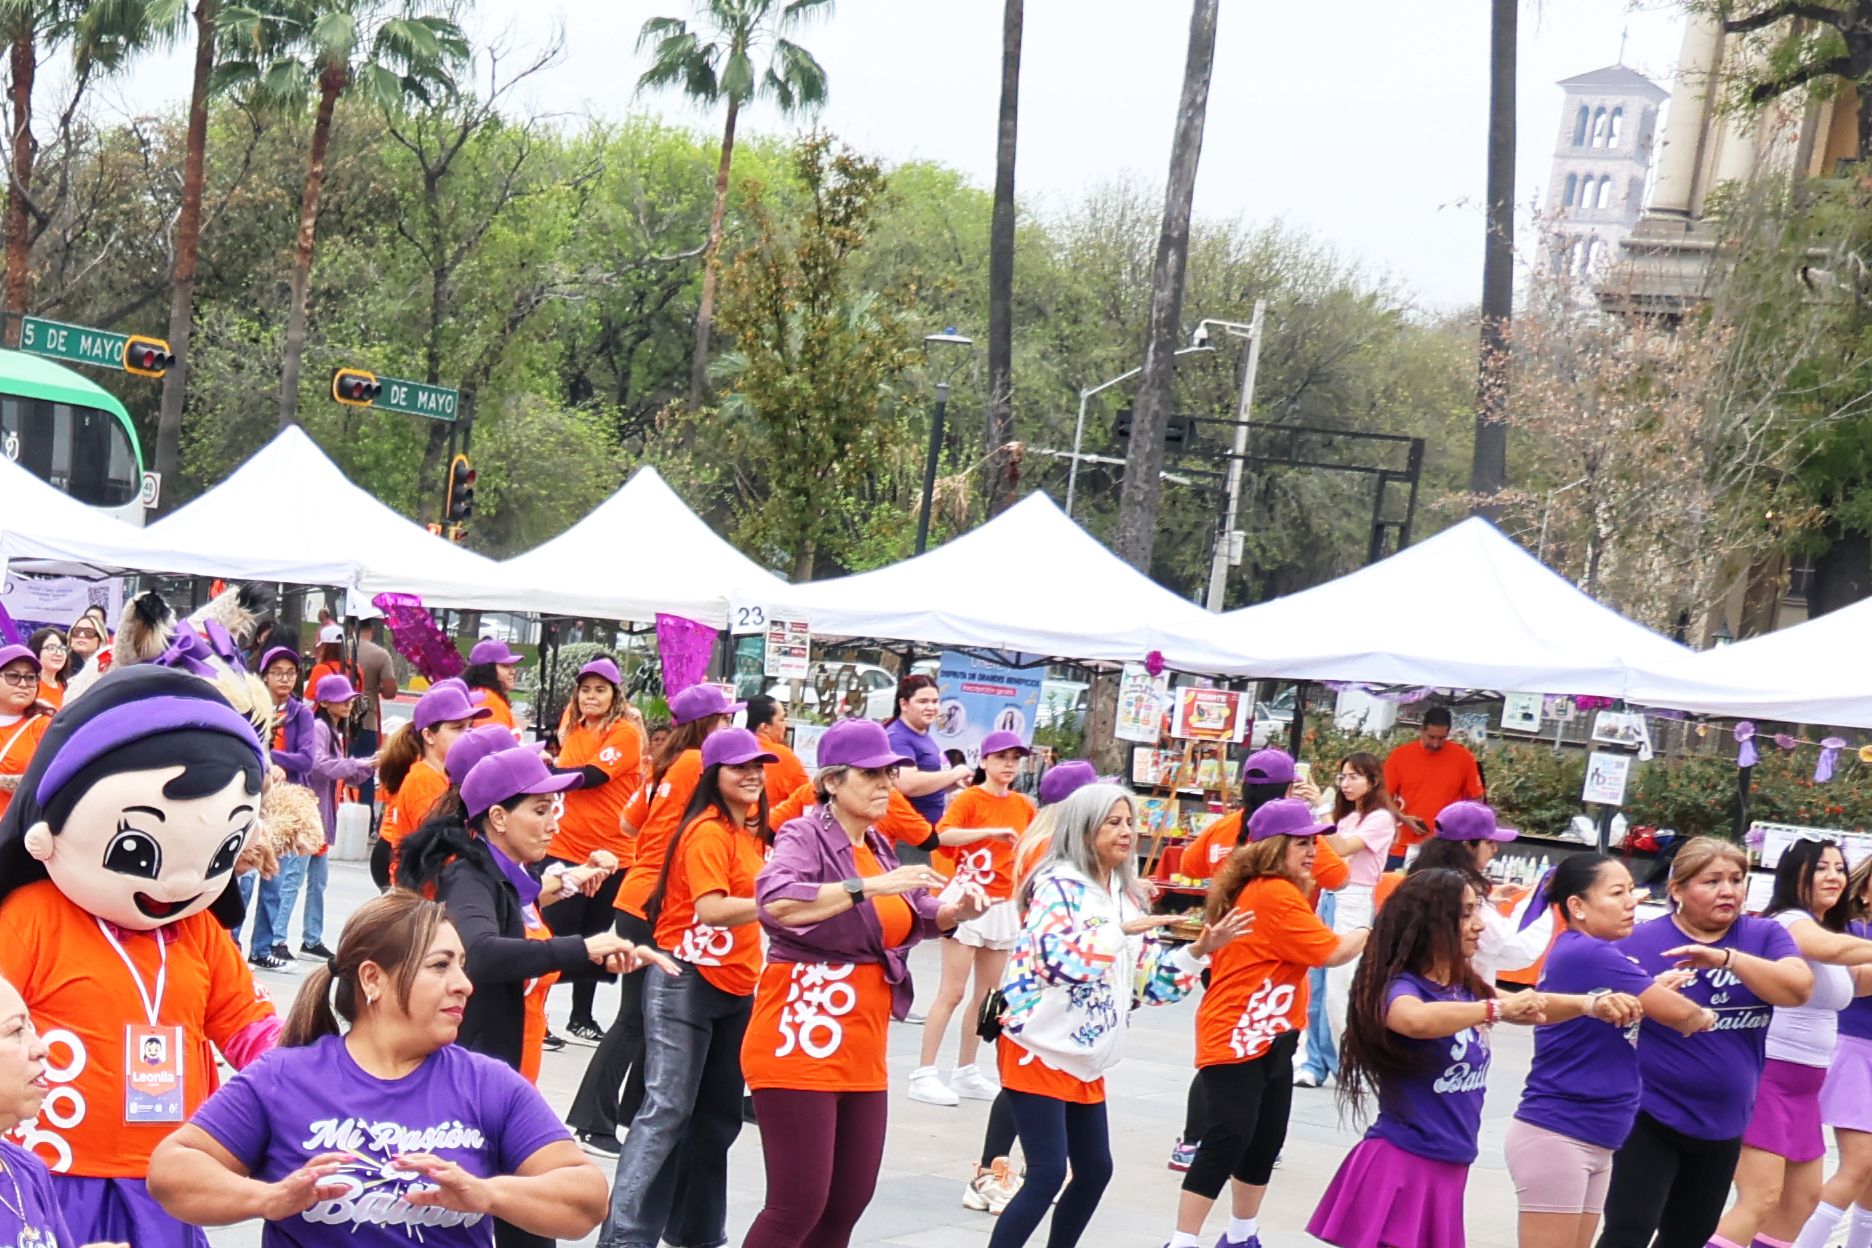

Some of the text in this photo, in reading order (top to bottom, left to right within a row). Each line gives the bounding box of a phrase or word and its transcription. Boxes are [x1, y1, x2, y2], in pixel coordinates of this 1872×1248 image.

[24, 324, 124, 361] 5 DE MAYO
[390, 385, 454, 413] DE MAYO
[737, 606, 765, 626] 23
[1710, 991, 1730, 1005] es
[302, 1117, 366, 1151] Mi
